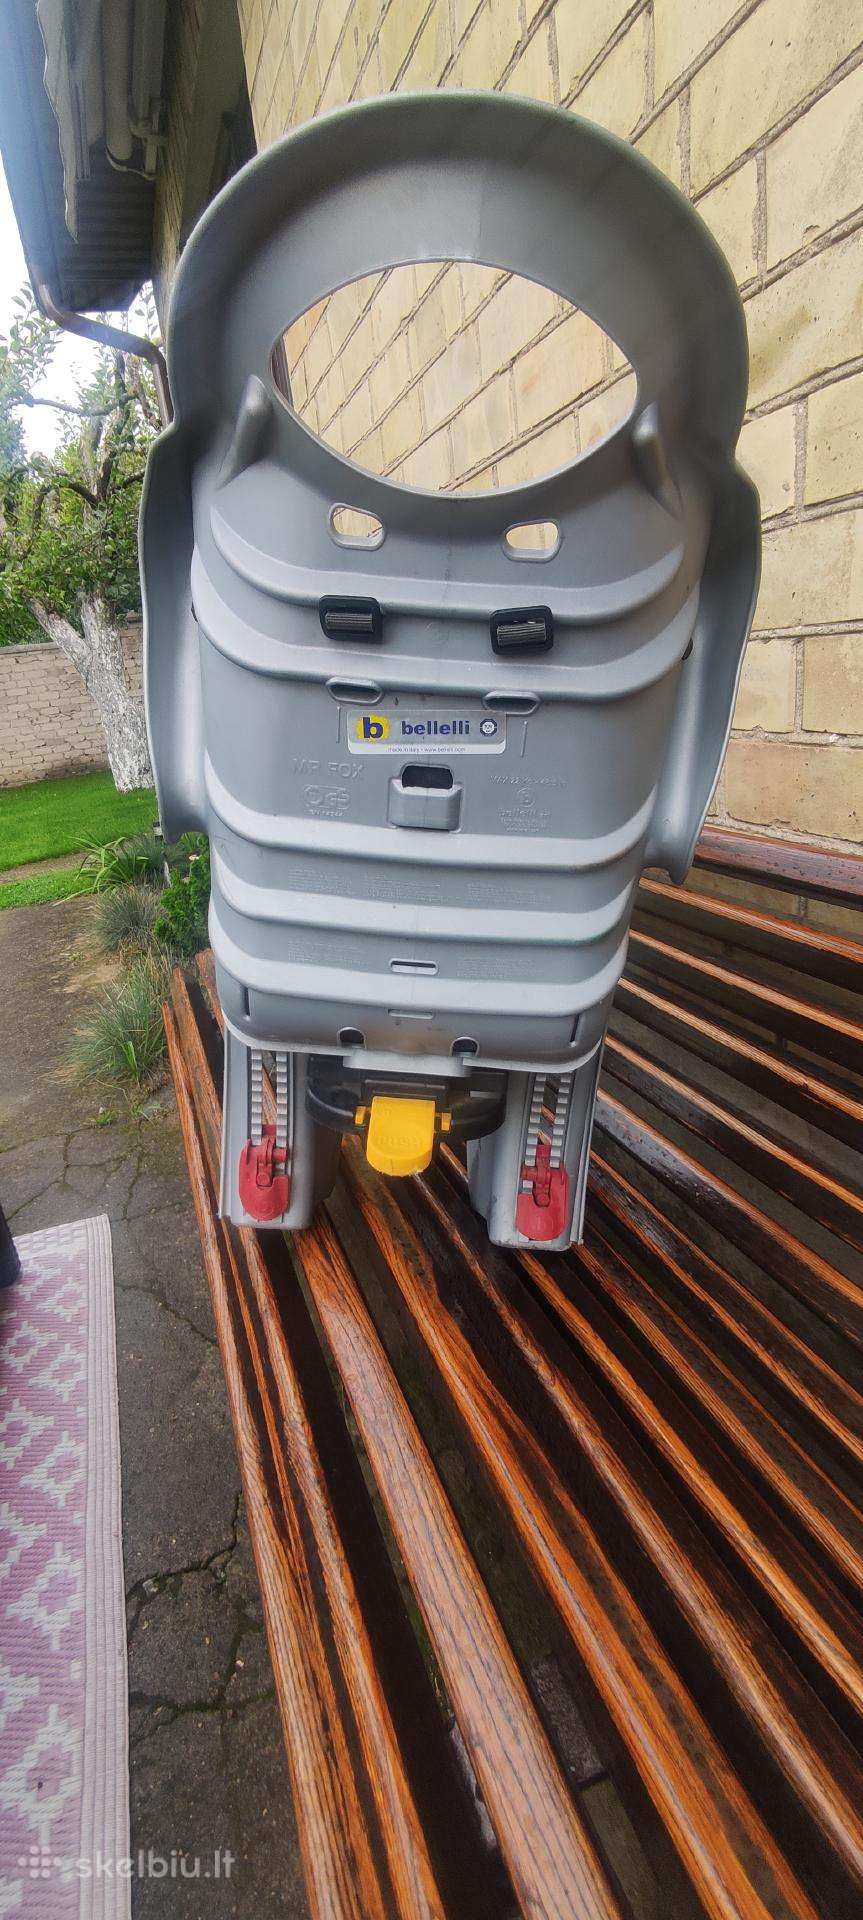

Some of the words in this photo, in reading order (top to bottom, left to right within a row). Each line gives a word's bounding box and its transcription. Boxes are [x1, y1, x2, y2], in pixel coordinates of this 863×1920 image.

[362, 716, 384, 739] b
[401, 720, 470, 735] bellelli
[327, 760, 365, 779] FOX
